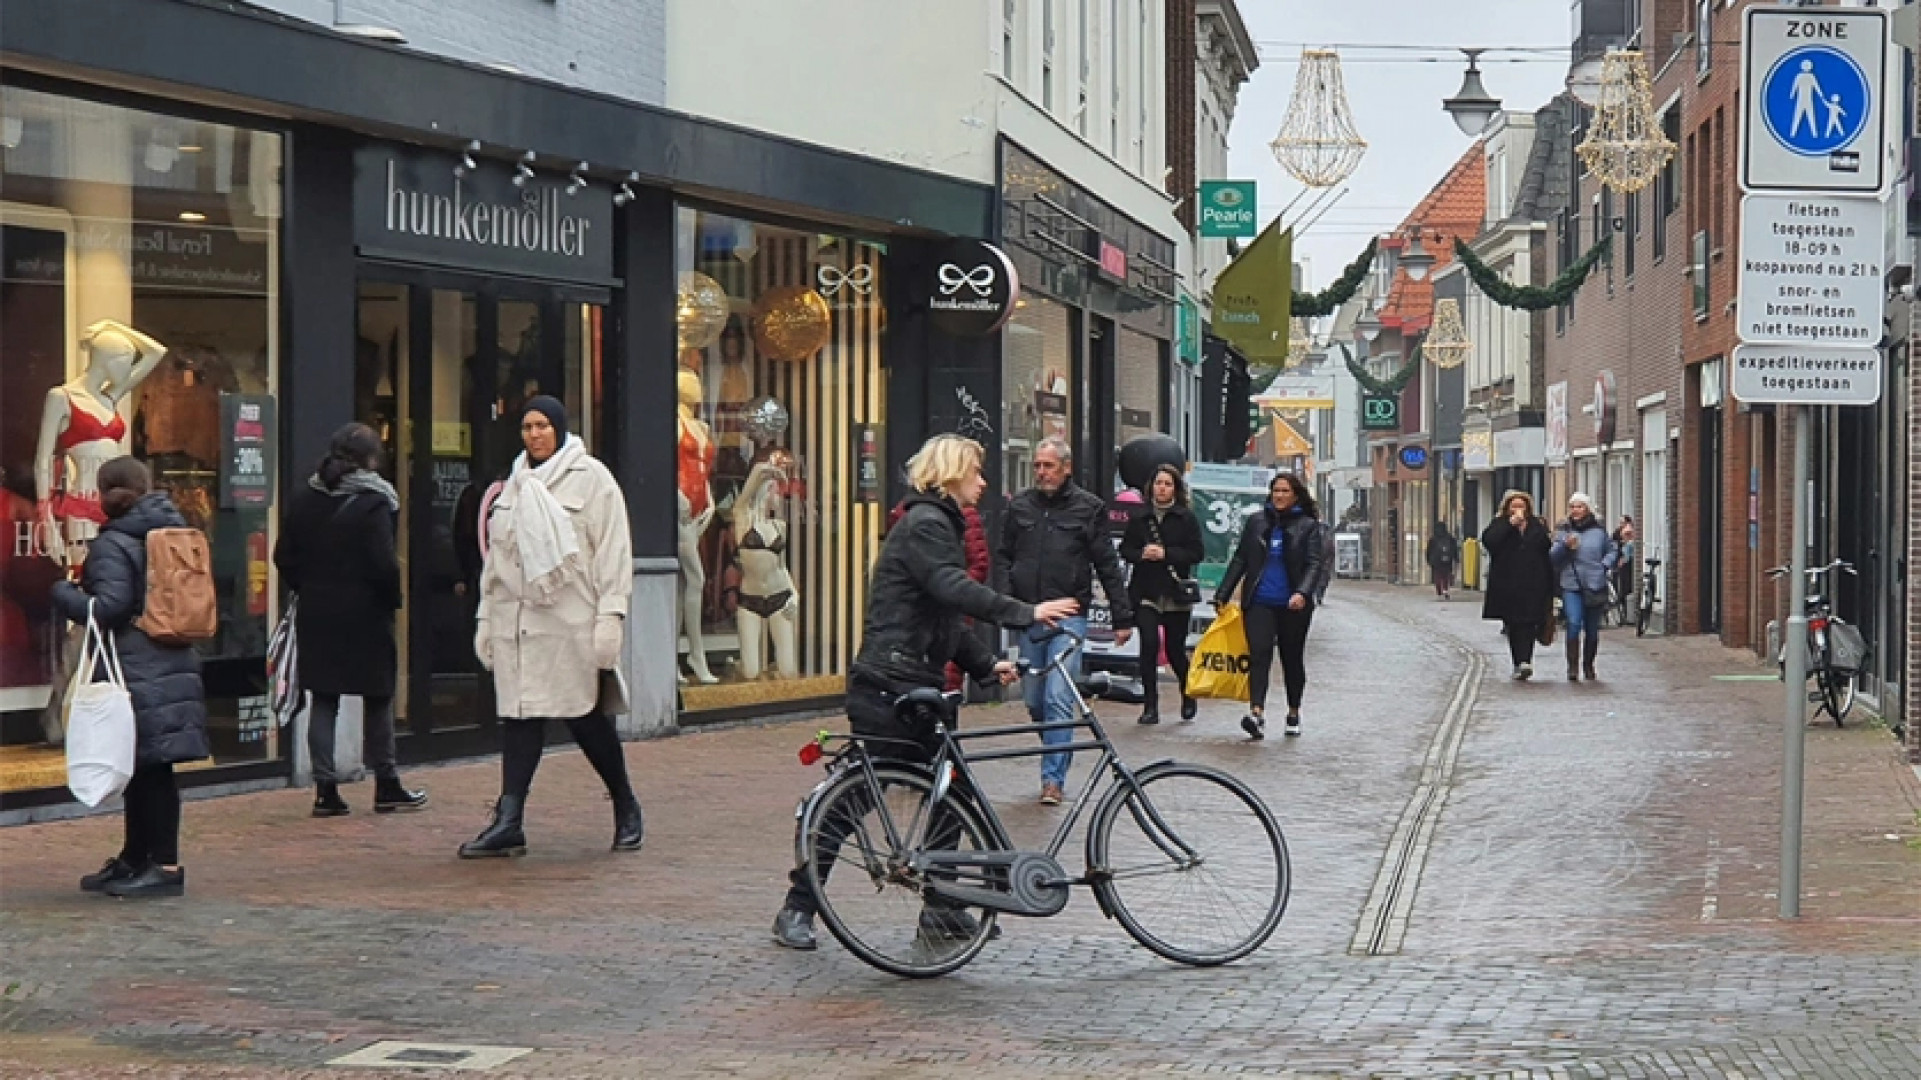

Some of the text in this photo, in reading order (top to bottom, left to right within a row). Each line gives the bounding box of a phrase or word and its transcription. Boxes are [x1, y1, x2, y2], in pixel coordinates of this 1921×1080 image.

[1787, 21, 1849, 39] ZONE
[1203, 207, 1253, 222] Pearle
[1787, 202, 1840, 217] fietsen
[1771, 222, 1856, 239] toegestaan
[1784, 241, 1842, 256] 18-09 h
[1746, 260, 1881, 277] koopavond na 21 h
[1778, 286, 1841, 299] snor- en
[1765, 301, 1856, 318] bromfietsen
[1752, 321, 1870, 340] niet toegestaan
[1738, 355, 1876, 371] expeditieverkeer
[1761, 376, 1851, 393] toegestaan
